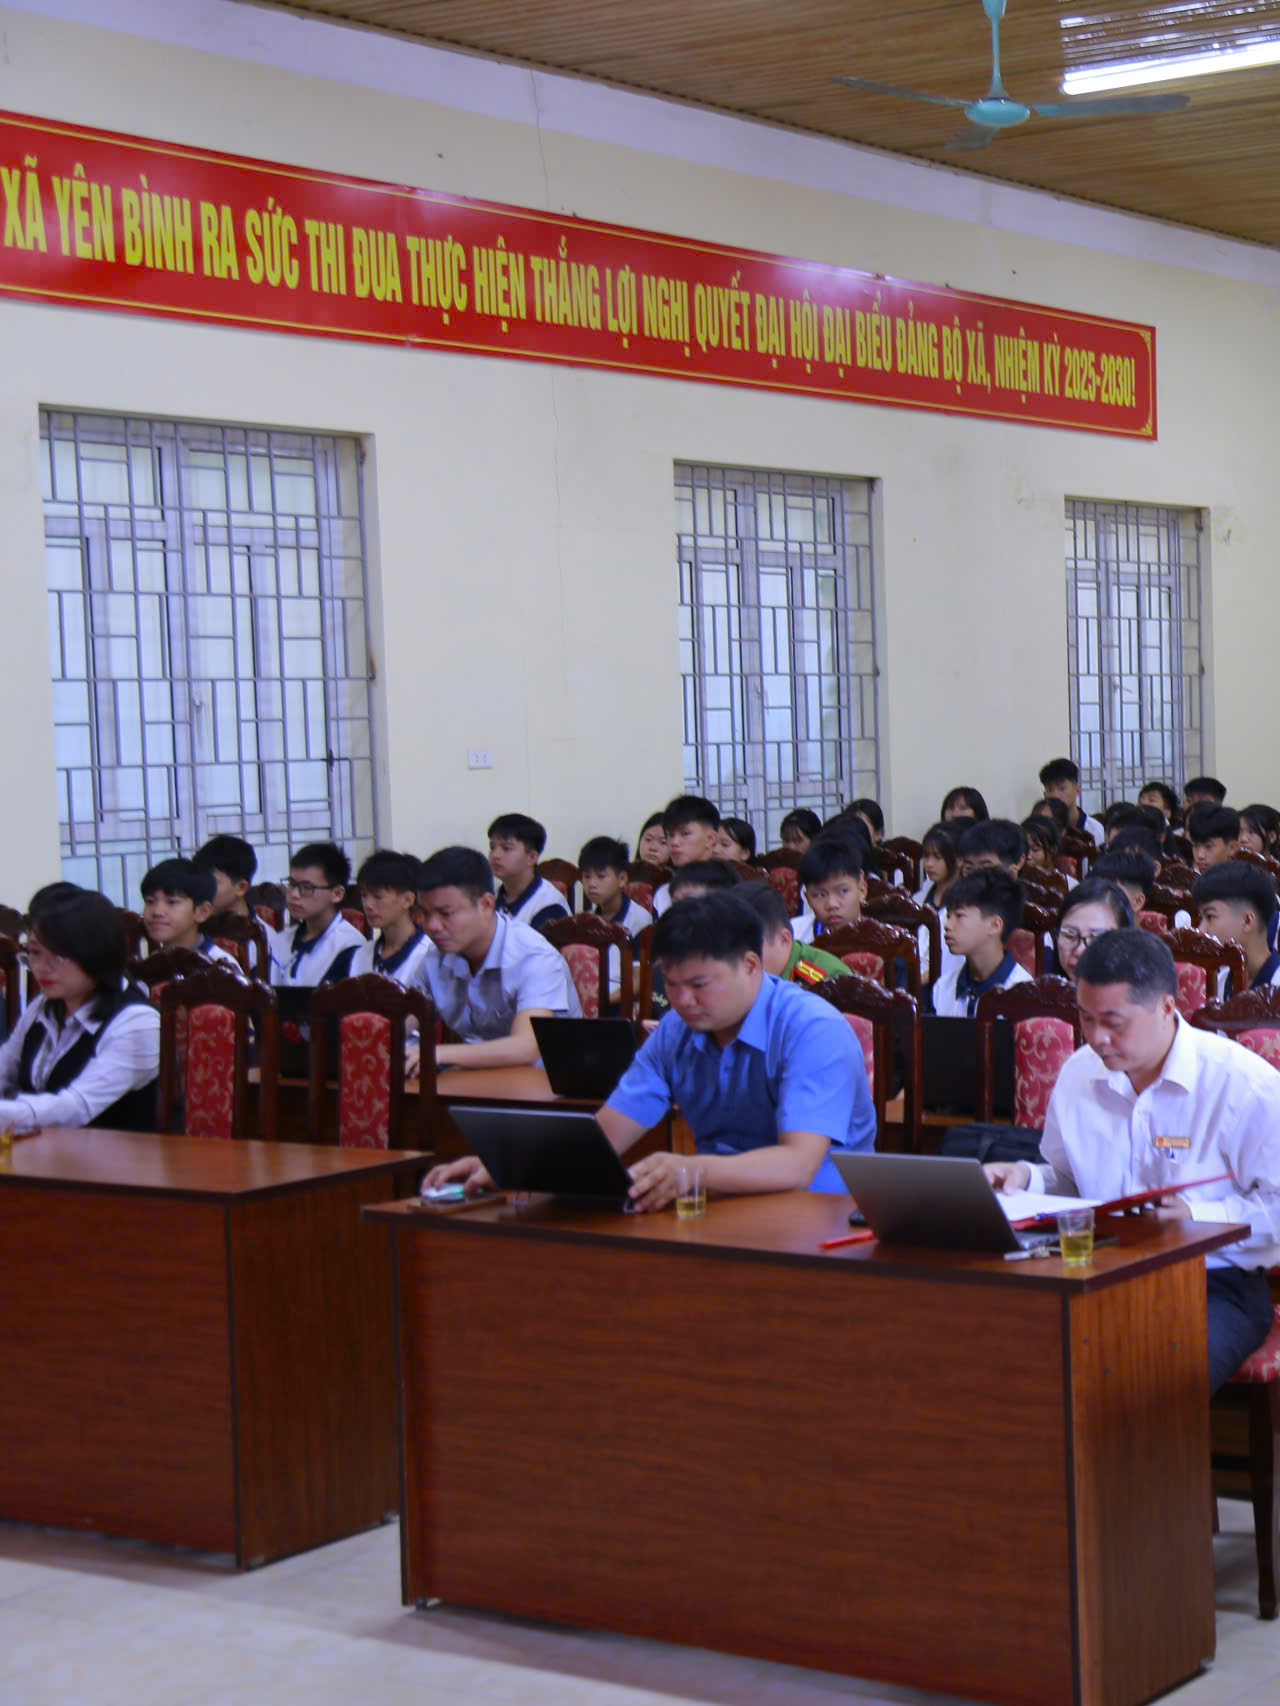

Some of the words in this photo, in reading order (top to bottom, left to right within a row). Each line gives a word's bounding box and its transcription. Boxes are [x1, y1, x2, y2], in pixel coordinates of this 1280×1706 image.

[1, 155, 47, 253] XÃ
[52, 162, 115, 263] YÊN
[121, 174, 194, 274] BÌNH
[199, 200, 239, 281] RA
[245, 196, 299, 289] SỨC
[304, 218, 347, 296] THI
[352, 226, 403, 303] ĐUA
[405, 234, 468, 325] THỰC
[472, 234, 527, 333] HIỆN
[530, 235, 602, 330] THẮNG
[604, 264, 638, 349] LỢI
[641, 273, 690, 358] NGHỊ
[694, 269, 750, 353] QUYẾT
[755, 291, 786, 369] ĐẠI
[789, 287, 820, 374] HỘI
[822, 303, 852, 378] ĐẠI
[855, 289, 892, 373] BIỂU
[895, 300, 940, 380] ĐẢNG
[941, 314, 963, 395] BỘ
[966, 322, 992, 395] XÃ,
[993, 327, 1041, 404] NHIỆM
[1043, 332, 1061, 397] KỲ
[1064, 345, 1136, 408] 2025-2030!
